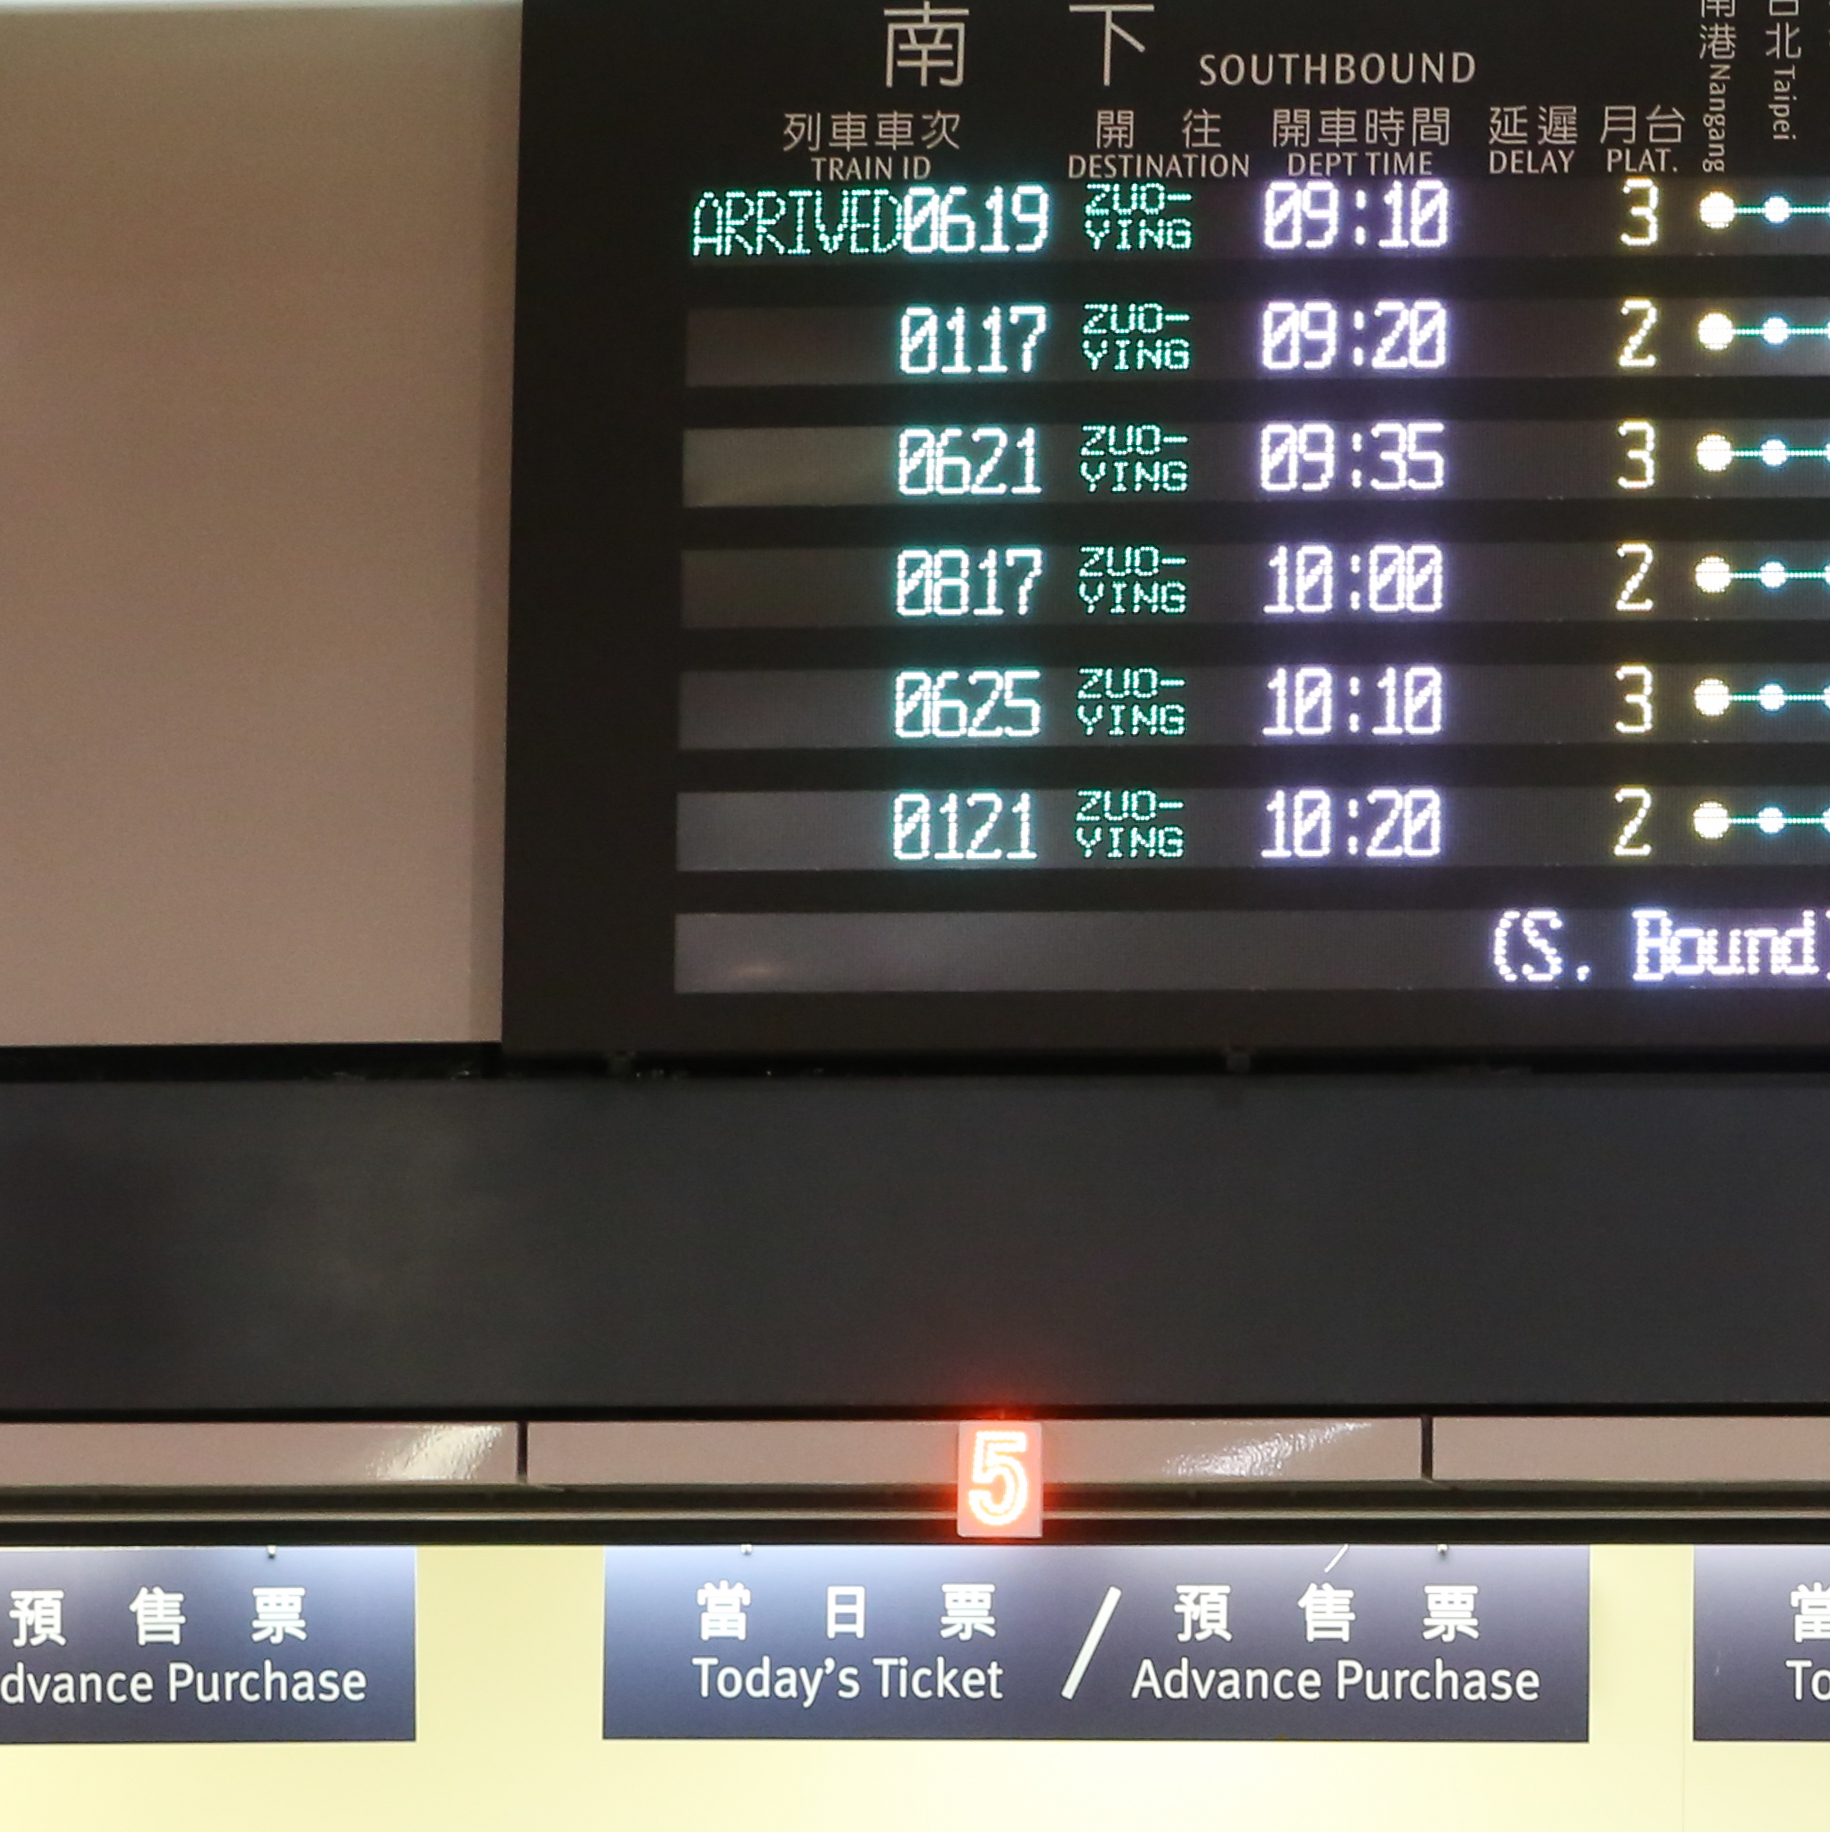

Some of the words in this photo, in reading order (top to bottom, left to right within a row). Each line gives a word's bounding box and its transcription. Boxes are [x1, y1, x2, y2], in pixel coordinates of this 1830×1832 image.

[1200, 52, 1475, 85] SOUTHBOUND
[1769, 65, 1797, 139] Taipei
[784, 110, 960, 152] 列車車次
[1273, 107, 1449, 147] 開車時間
[1489, 105, 1579, 148] 延遲
[1600, 105, 1685, 148] 月台
[1703, 65, 1730, 172] Nangang
[811, 156, 892, 181] TRAIN
[904, 157, 930, 179] ID
[1069, 154, 1249, 181] DESTINATION
[1287, 153, 1357, 178] DEPT
[1366, 152, 1434, 177] TIME
[1490, 150, 1574, 173] DELAY
[1607, 148, 1677, 172] PLAT.
[693, 189, 902, 255] ARRIVED
[902, 184, 1048, 254] 0619
[1085, 183, 1191, 216] ZUO-
[1264, 179, 1448, 250] 09:10
[1621, 177, 1658, 246] 3
[1085, 219, 1191, 250] YING
[900, 305, 1046, 374] 0117
[1083, 303, 1189, 334] ZUO-
[1262, 300, 1447, 370] 09:20
[1619, 298, 1657, 367] 2
[1083, 339, 1189, 370] YING
[899, 427, 1041, 495] 0621
[1261, 422, 1444, 491] 09:35
[1618, 420, 1655, 489] 3
[897, 548, 1042, 616] 0817
[1264, 544, 1443, 614] 10:00
[1616, 542, 1653, 611] 2
[895, 670, 1040, 738] 0625
[1263, 666, 1442, 736] 10:10
[1616, 665, 1652, 733] 3
[893, 793, 1037, 860] 0121
[1262, 788, 1441, 858] 10:20
[1614, 788, 1651, 856] 2
[1493, 909, 1590, 982] (S.
[966, 1429, 1029, 1528] 5
[9, 1585, 309, 1646] 預售票
[694, 1578, 995, 1640] 當日票
[1175, 1583, 1478, 1641] 預售票
[1, 1662, 153, 1703] dvance
[170, 1660, 366, 1702] Purchase
[873, 1657, 1002, 1698] Ticket
[1132, 1658, 1321, 1699] Advance
[1338, 1658, 1539, 1700] Purchase
